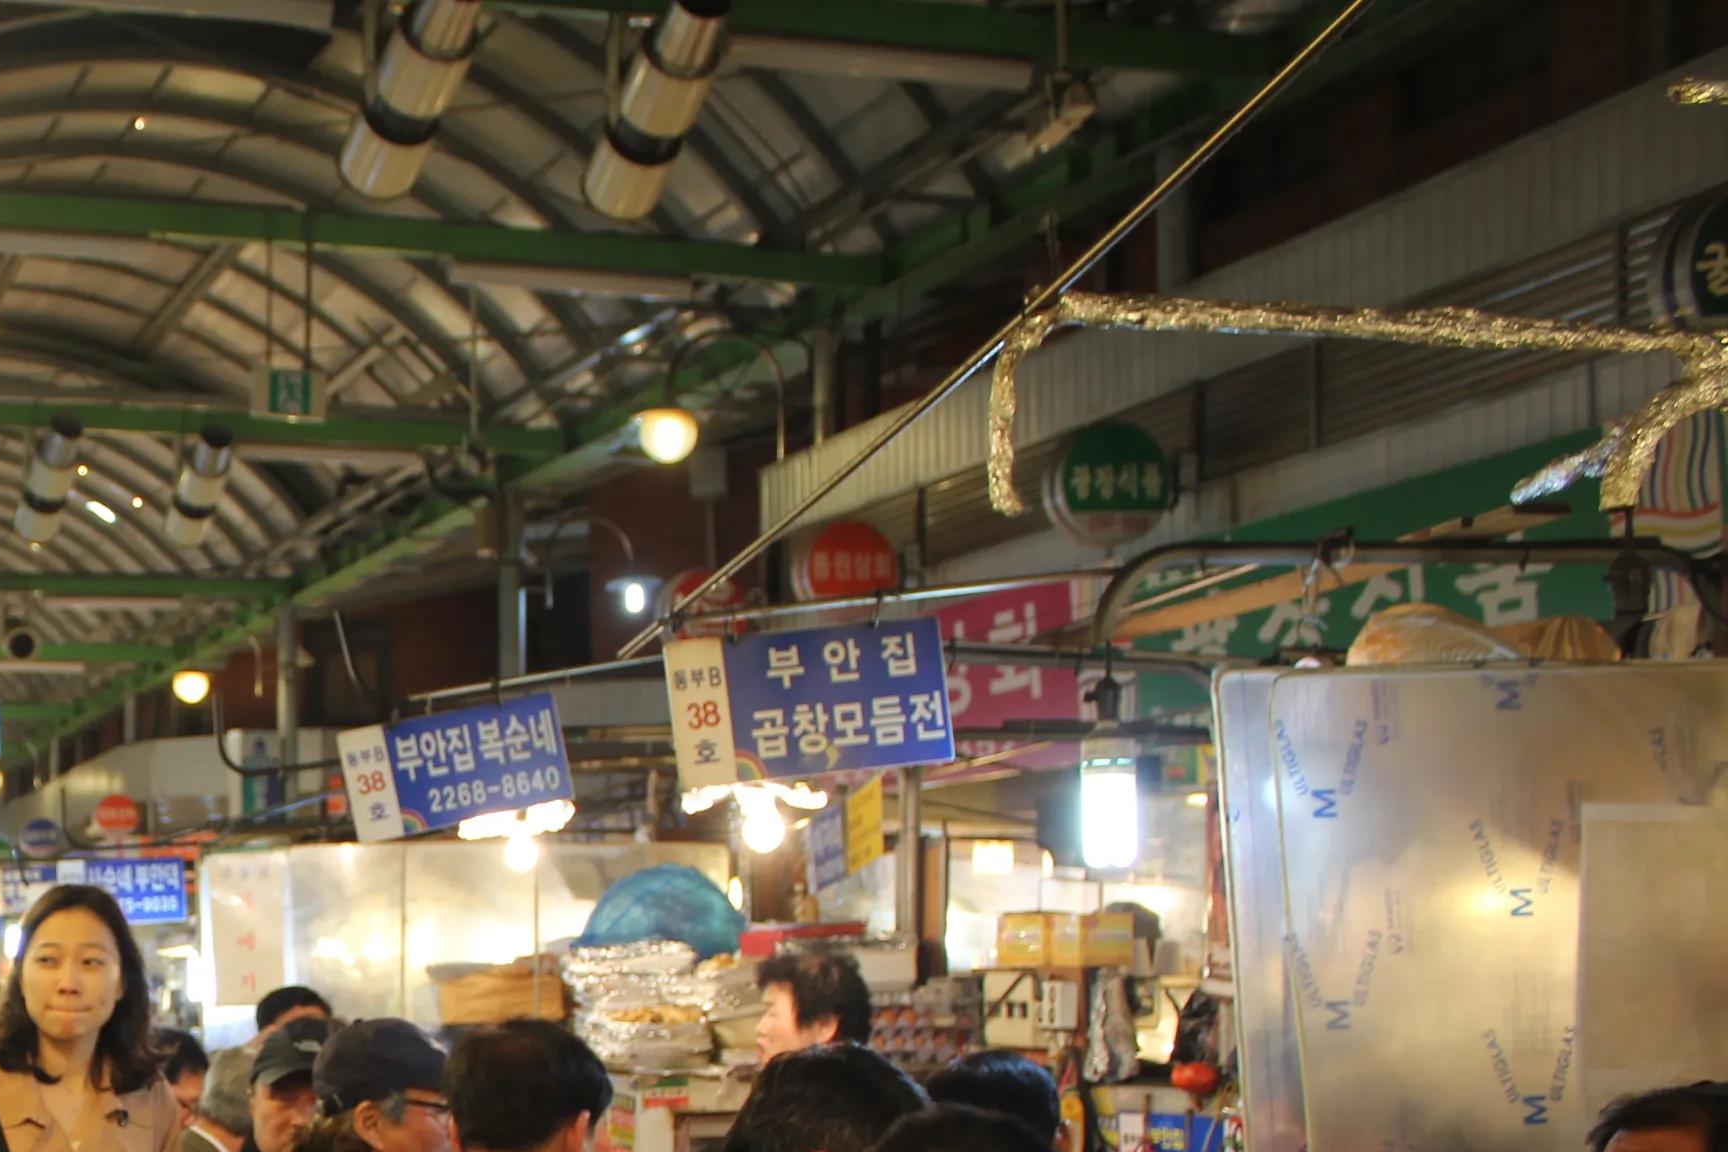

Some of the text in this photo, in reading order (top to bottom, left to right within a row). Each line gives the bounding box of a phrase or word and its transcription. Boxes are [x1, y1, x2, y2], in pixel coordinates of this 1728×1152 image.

[673, 664, 722, 691] 동부B
[1497, 680, 1522, 711] M
[687, 700, 722, 731] 38
[751, 690, 948, 760] 곱창모듬전
[396, 708, 558, 782] 부안집 복순네
[693, 739, 721, 765] 호
[357, 771, 387, 796] 38
[428, 765, 561, 814] 2268-8640
[369, 803, 390, 822] 호
[1311, 788, 1338, 819] M
[1509, 888, 1534, 918] M
[1326, 1000, 1351, 1031] M
[1523, 1095, 1549, 1126] M
